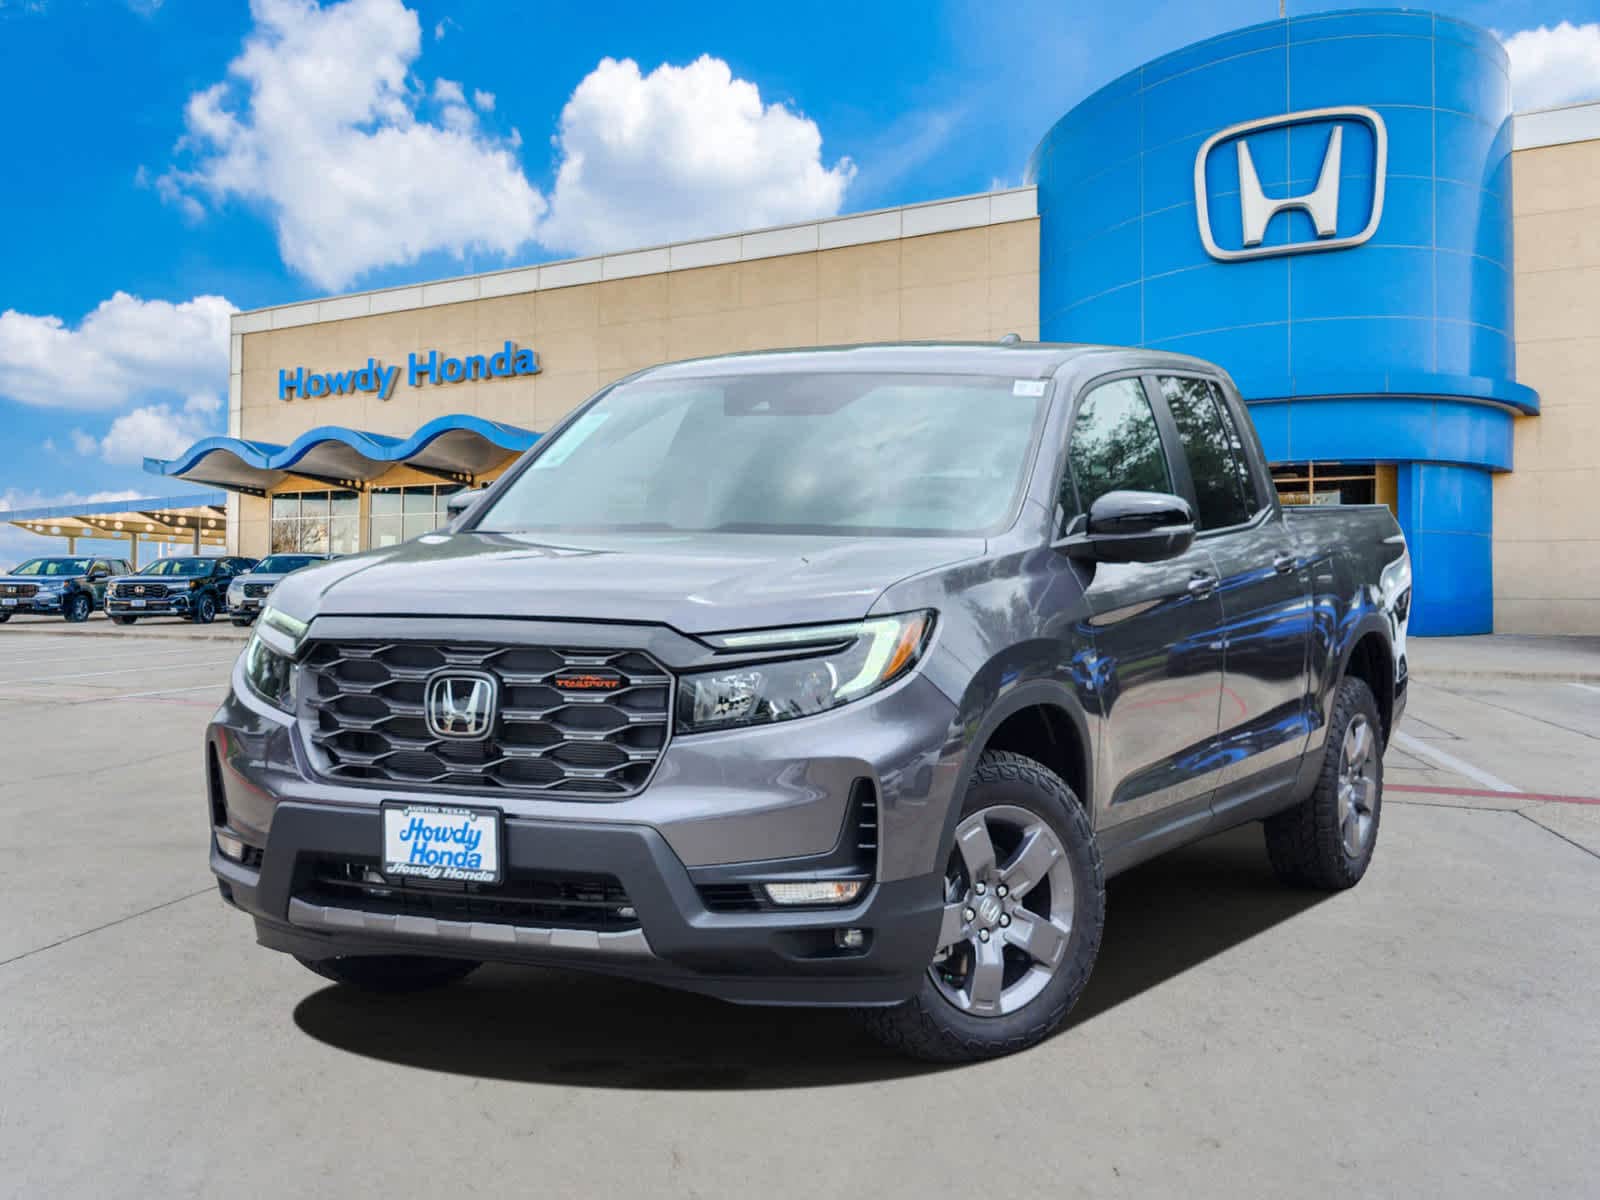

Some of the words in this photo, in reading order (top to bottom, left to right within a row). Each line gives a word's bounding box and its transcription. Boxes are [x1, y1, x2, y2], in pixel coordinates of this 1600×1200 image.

[279, 358, 399, 401] Howdy
[407, 340, 541, 387] Honda
[400, 818, 483, 851] Howdy
[409, 841, 482, 868] Honda
[386, 863, 442, 879] Howdy
[442, 867, 495, 882] Honda
